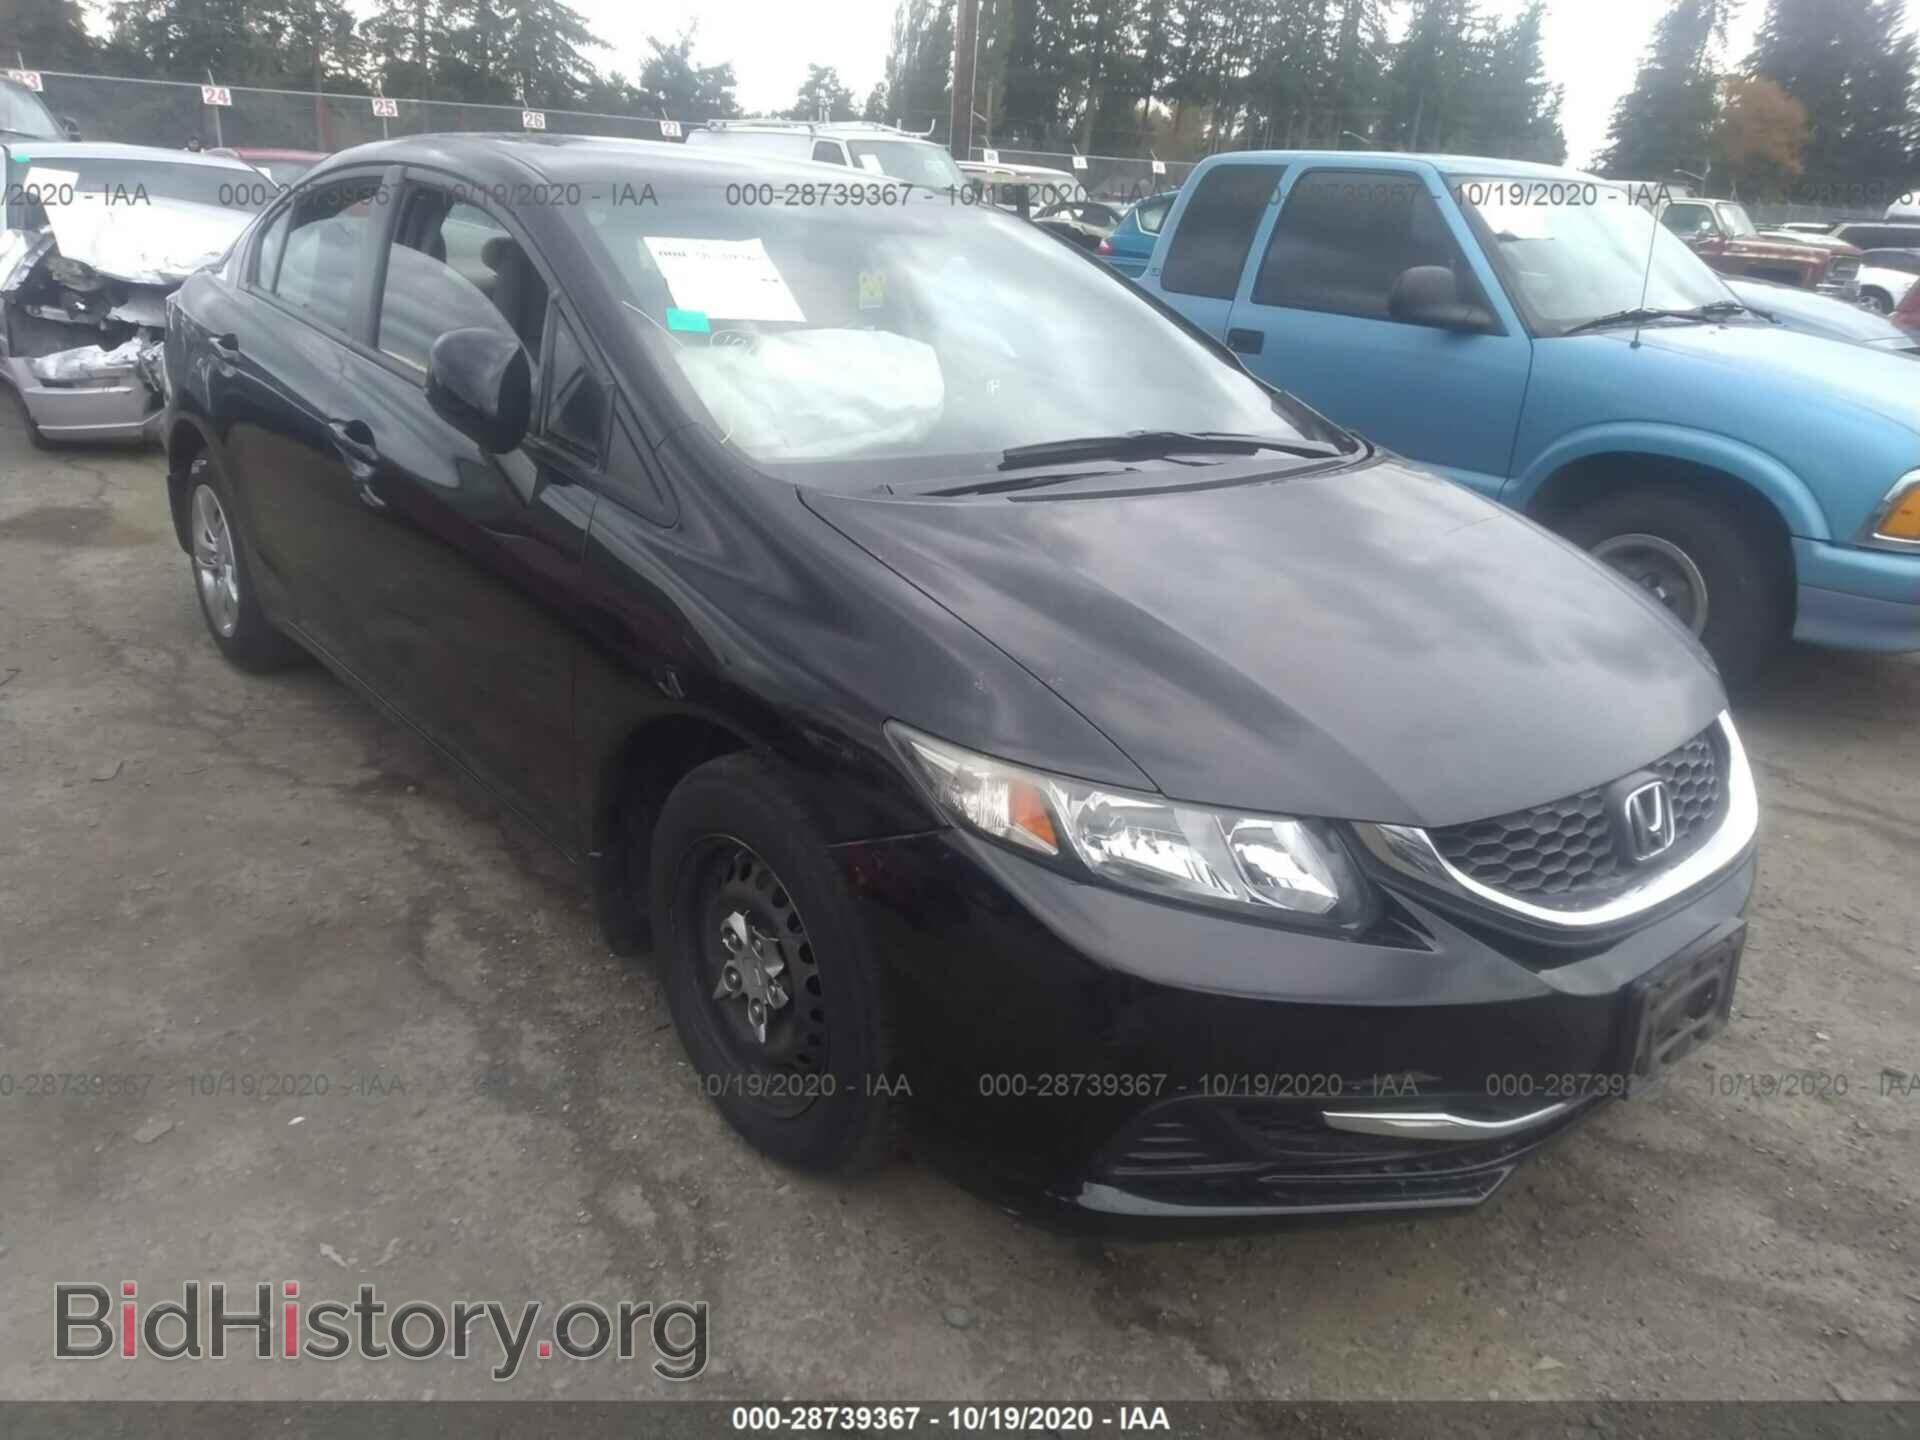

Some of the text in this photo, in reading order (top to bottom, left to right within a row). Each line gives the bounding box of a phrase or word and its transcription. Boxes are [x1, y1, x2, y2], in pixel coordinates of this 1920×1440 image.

[205, 88, 229, 104] 24
[374, 100, 395, 115] 25
[525, 113, 543, 127] 26
